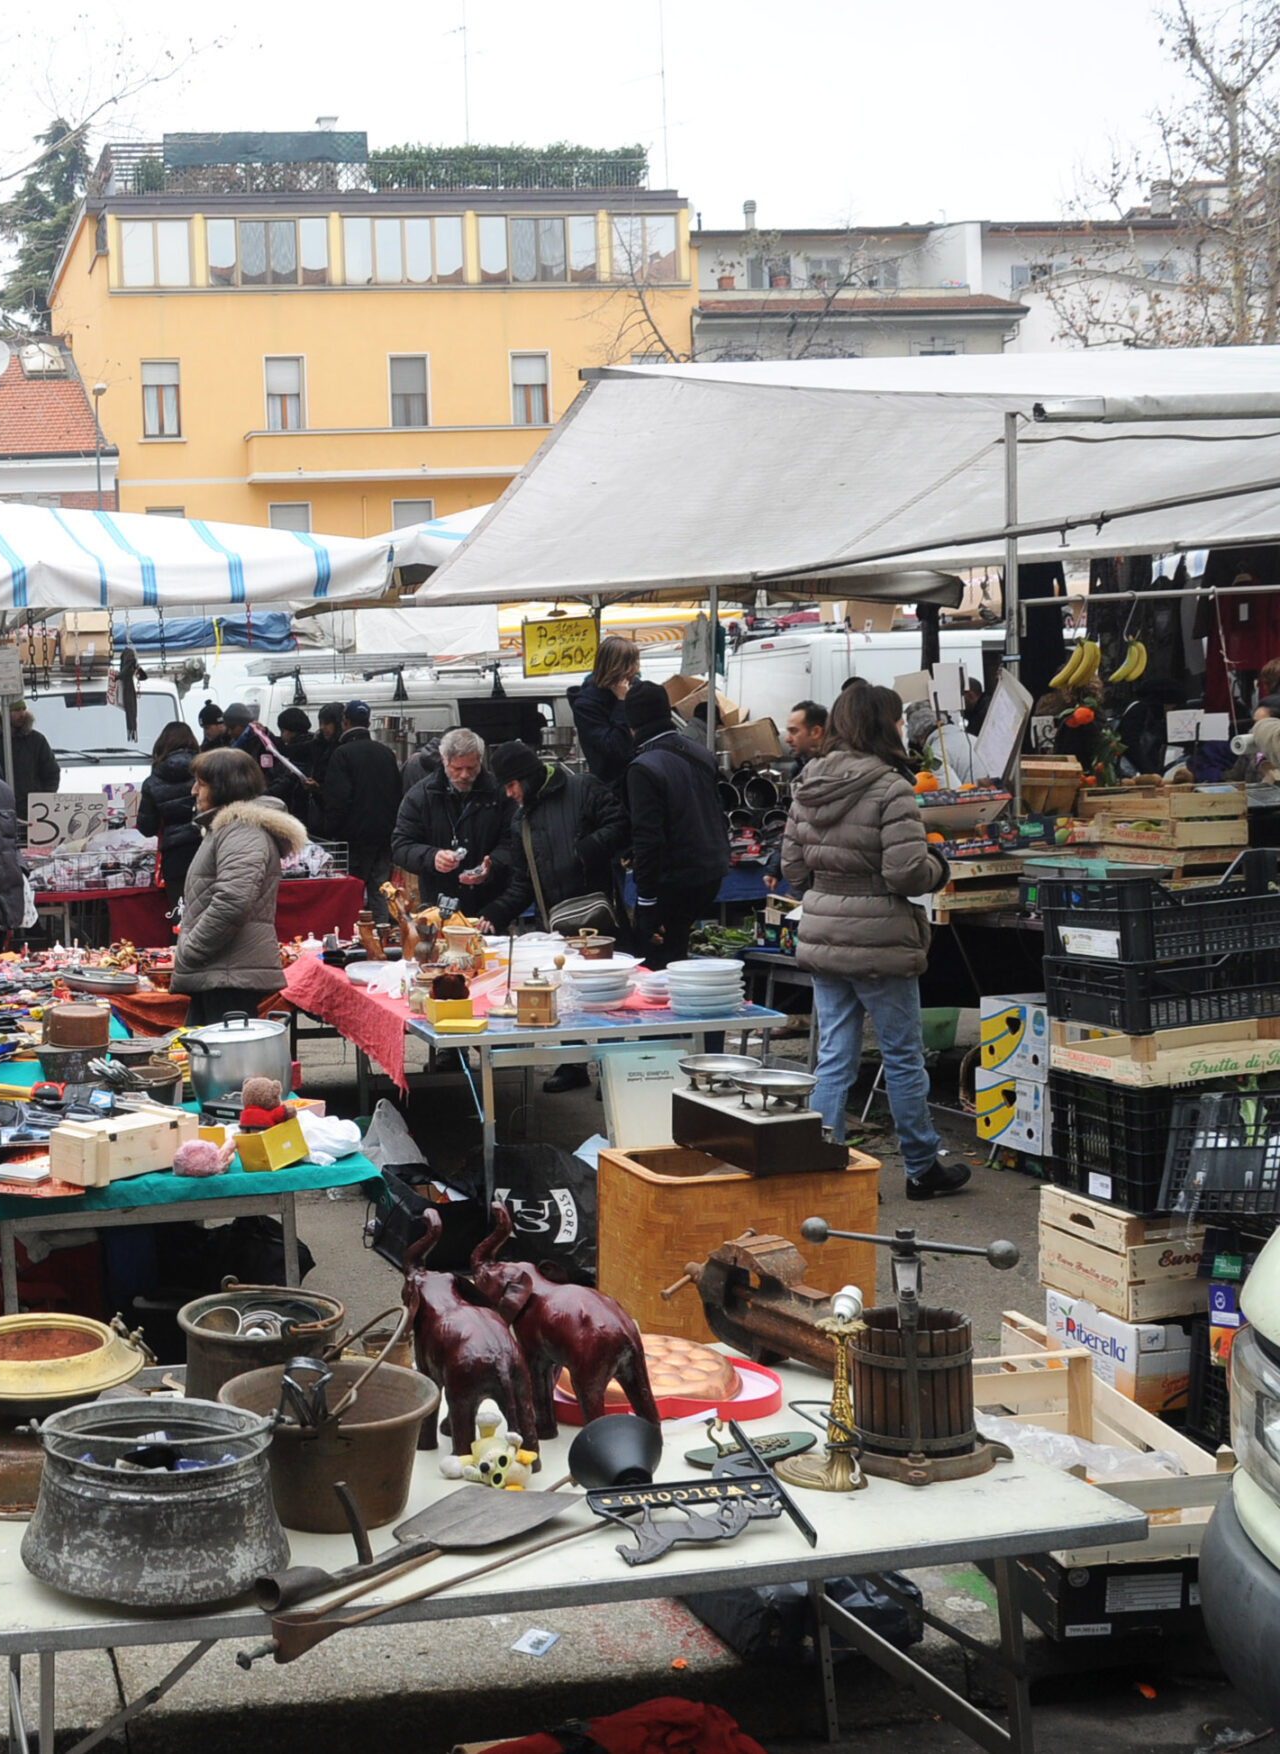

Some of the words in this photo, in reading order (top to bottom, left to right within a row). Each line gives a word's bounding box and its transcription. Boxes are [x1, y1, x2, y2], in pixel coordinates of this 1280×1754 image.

[1188, 1057, 1240, 1077] Frutta
[1245, 1053, 1261, 1069] di
[559, 1193, 575, 1237] STORE
[1158, 1249, 1201, 1268] Euro
[1065, 1316, 1127, 1363] Riberella
[618, 1485, 747, 1505] WELCOME
